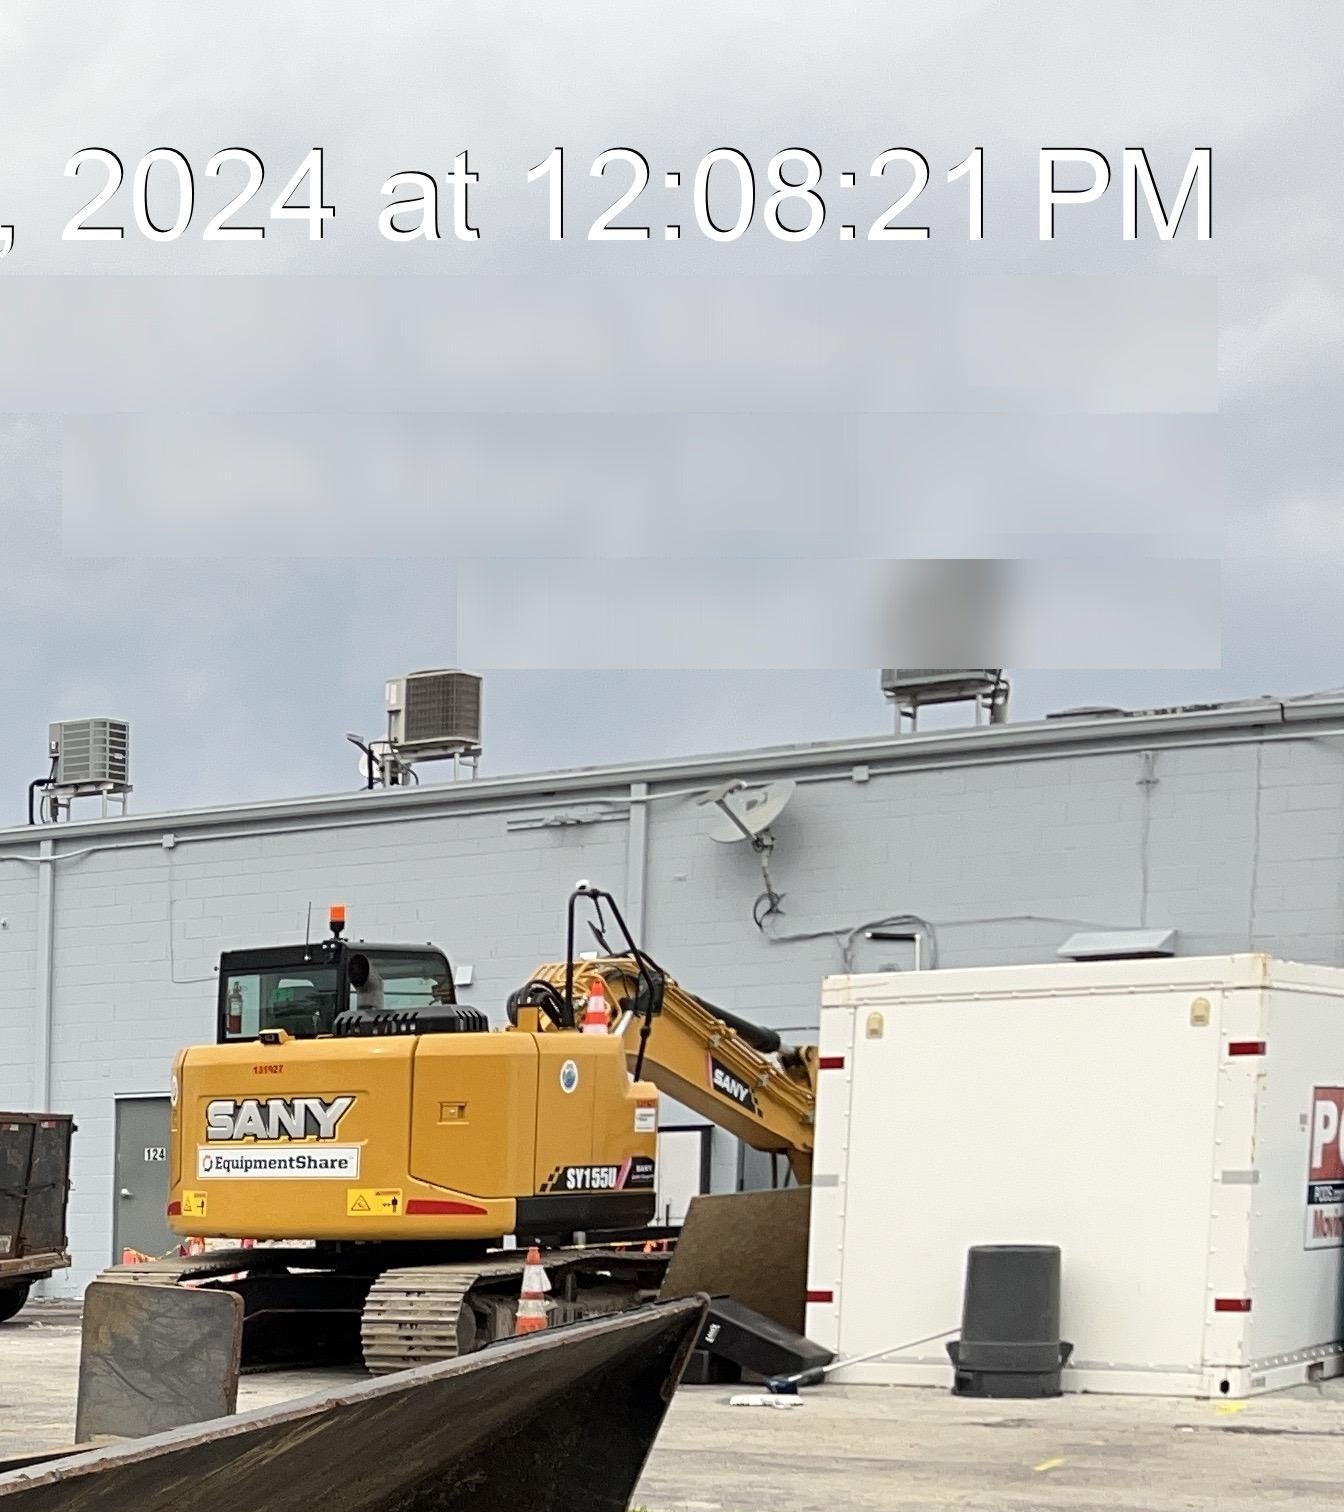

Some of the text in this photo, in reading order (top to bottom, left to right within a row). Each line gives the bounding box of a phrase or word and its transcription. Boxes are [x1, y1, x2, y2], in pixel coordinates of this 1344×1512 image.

[713, 1068, 749, 1103] SANY
[205, 1095, 357, 1142] SANY
[1312, 1099, 1344, 1169] P
[146, 1149, 166, 1161] 124
[214, 1154, 349, 1173] EquipmentShare
[566, 1166, 618, 1190] SY155U
